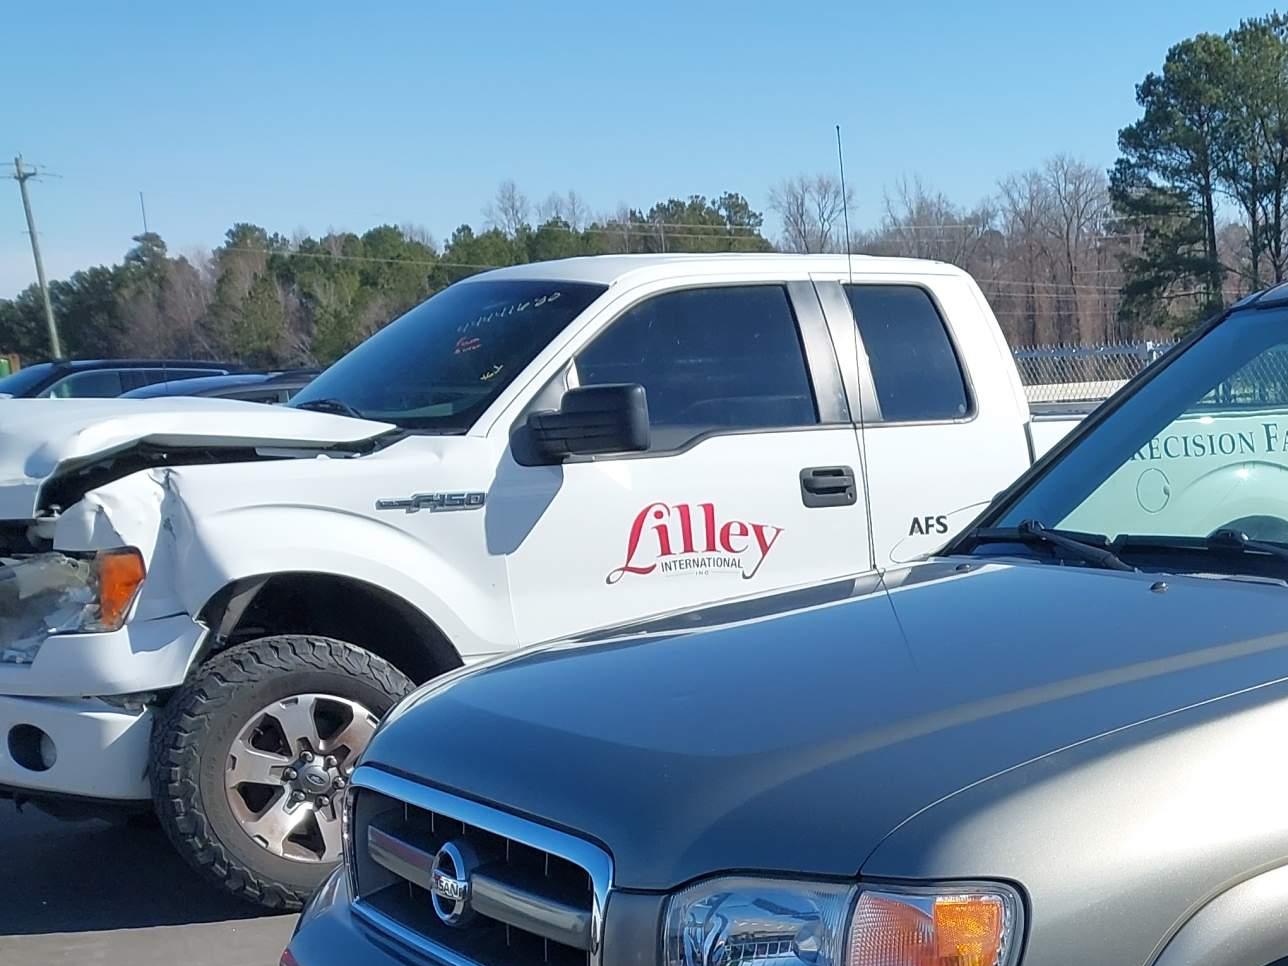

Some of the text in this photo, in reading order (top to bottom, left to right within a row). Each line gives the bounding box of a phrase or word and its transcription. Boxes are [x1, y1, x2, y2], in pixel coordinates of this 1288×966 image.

[908, 515, 949, 537] AFS
[605, 502, 785, 585] Lilley
[661, 556, 744, 572] INTERNATIONAL
